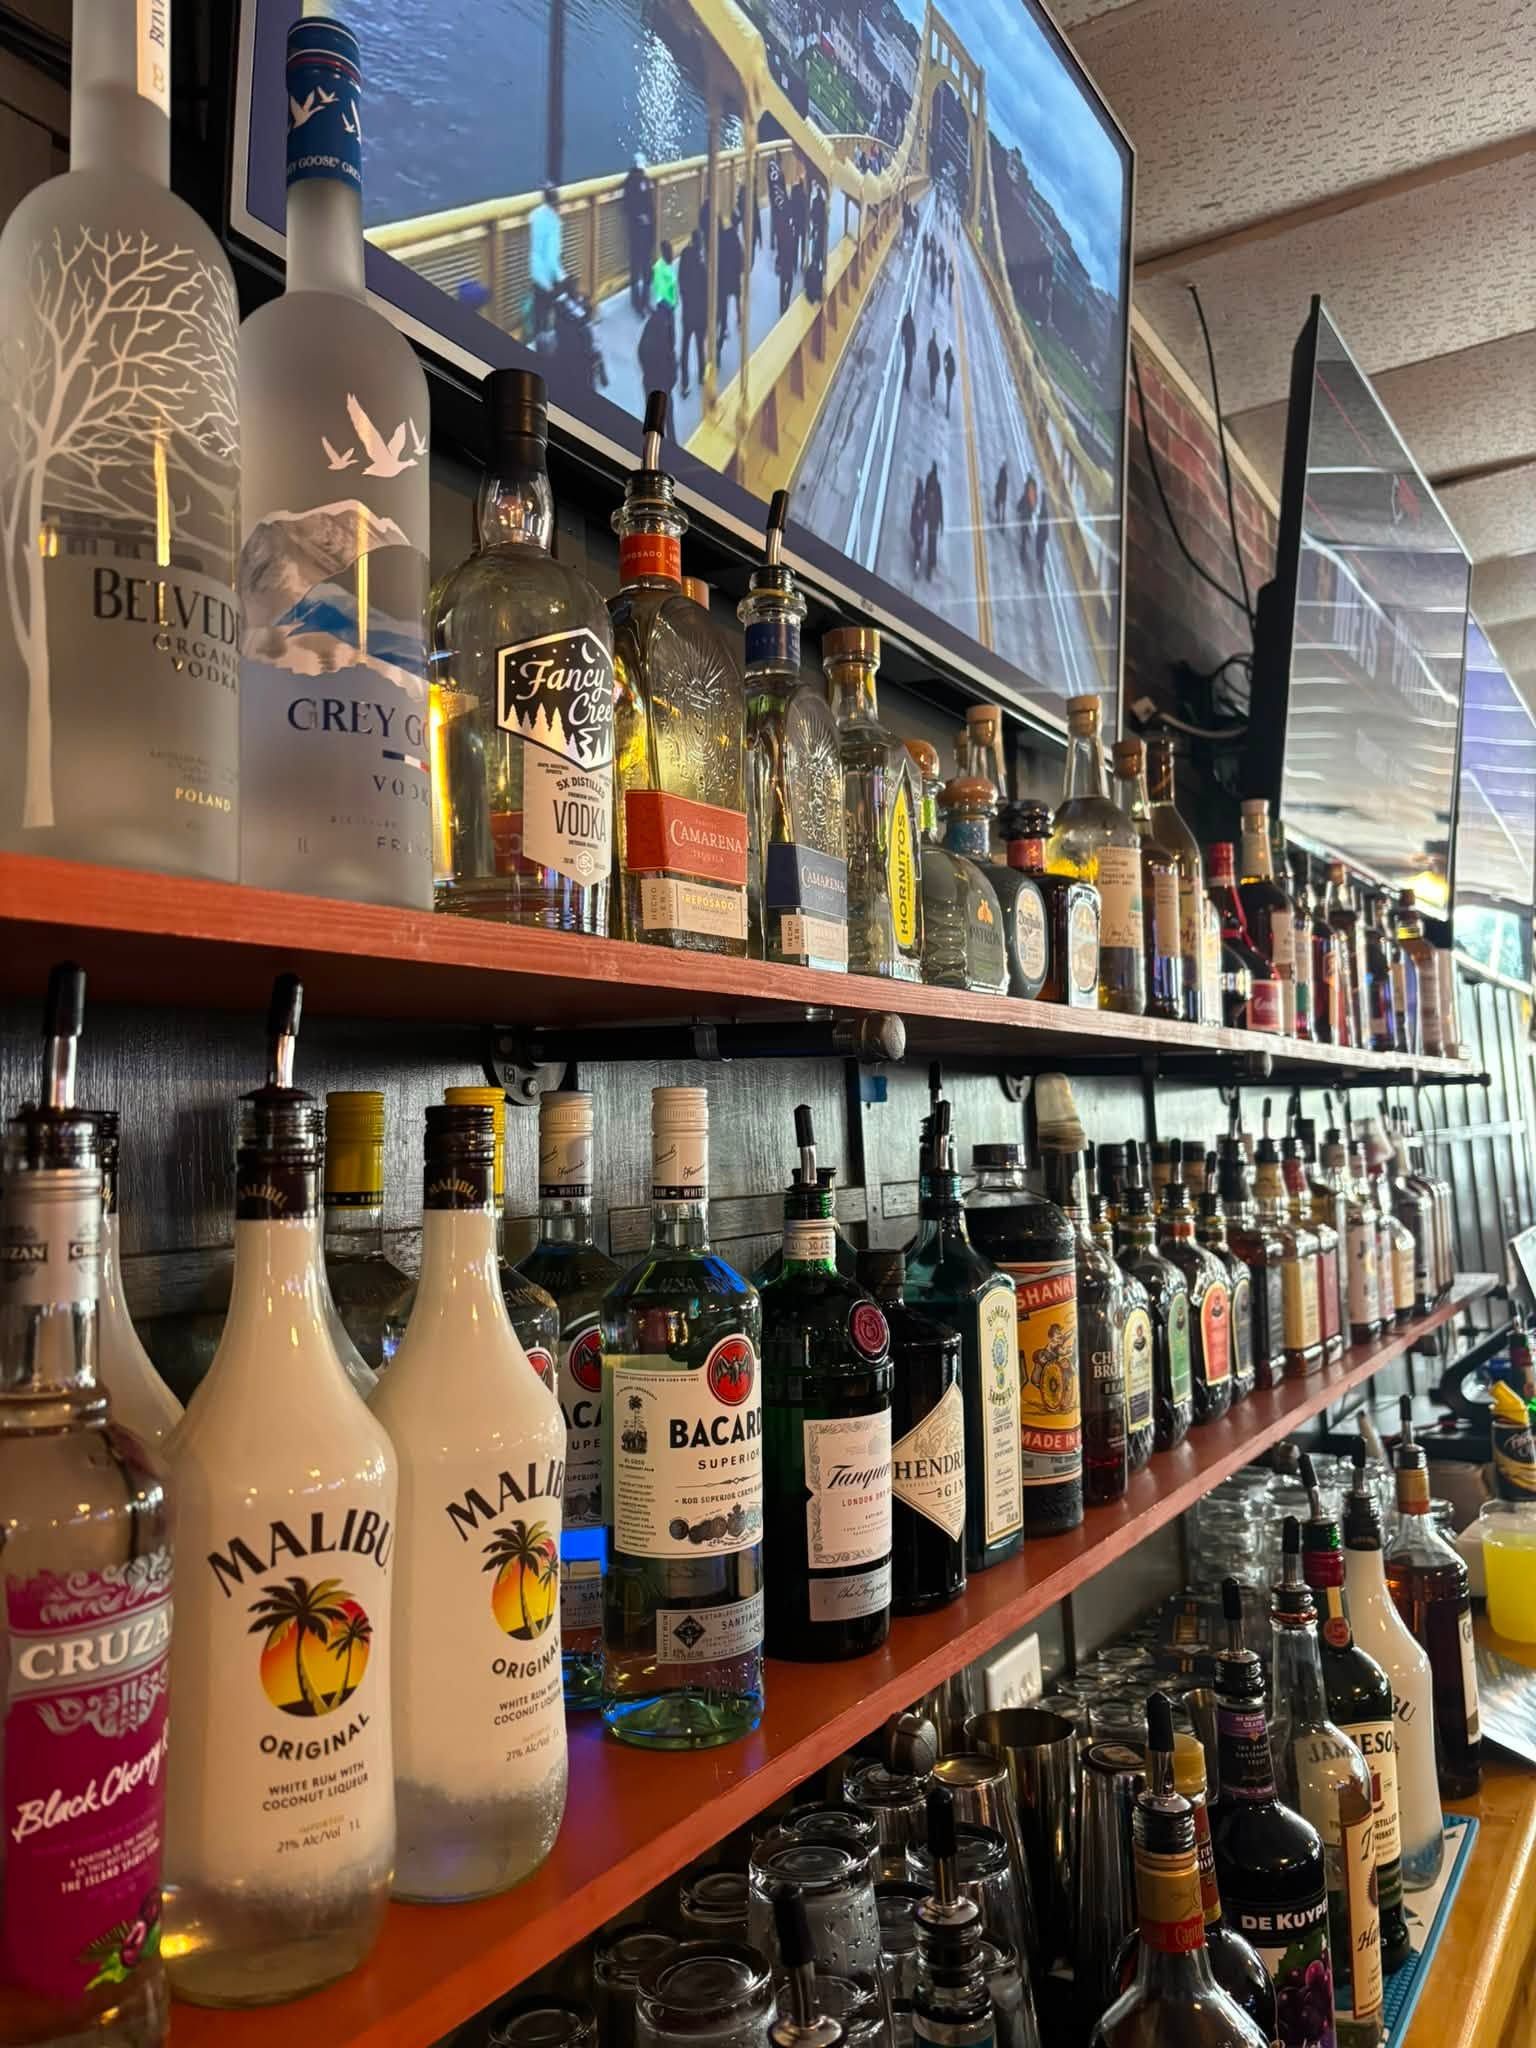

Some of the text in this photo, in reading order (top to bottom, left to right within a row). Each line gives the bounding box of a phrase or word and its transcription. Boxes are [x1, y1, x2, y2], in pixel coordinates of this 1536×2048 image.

[516, 659, 612, 703] Fancy
[288, 698, 395, 738] GREY
[556, 777, 570, 791] 5X
[175, 786, 232, 816] POLAND
[553, 799, 607, 843] VODKA
[670, 818, 744, 854] CAMARENA
[801, 864, 847, 895] CAMARENA
[898, 813, 910, 936] HORNITOS
[429, 1177, 478, 1198] MALIBU
[559, 1186, 583, 1196] WHITE
[683, 1189, 705, 1197] WHITE
[1022, 1431, 1061, 1449] MADE
[701, 1492, 736, 1504] SUPERIOR
[842, 1495, 873, 1507] LONDON
[207, 1508, 393, 1599] MALIBU
[19, 1602, 174, 1681] CRUZA
[491, 1636, 559, 1679] ORIGINAL
[494, 1703, 540, 1726] COCONUT
[499, 1696, 530, 1711] WHITE
[259, 1712, 371, 1761] ORIGINAL
[11, 1739, 161, 1844] Black Cherry
[262, 1772, 369, 1812] COCONUT LIQUEUR
[268, 1760, 365, 1797] WHITE RUM WITH
[277, 1839, 301, 1854] 21%
[302, 1826, 341, 1848] Alc/Vol
[61, 1878, 81, 1894] THE
[84, 1865, 121, 1887] ISLAND
[1241, 1914, 1273, 1931] DE
